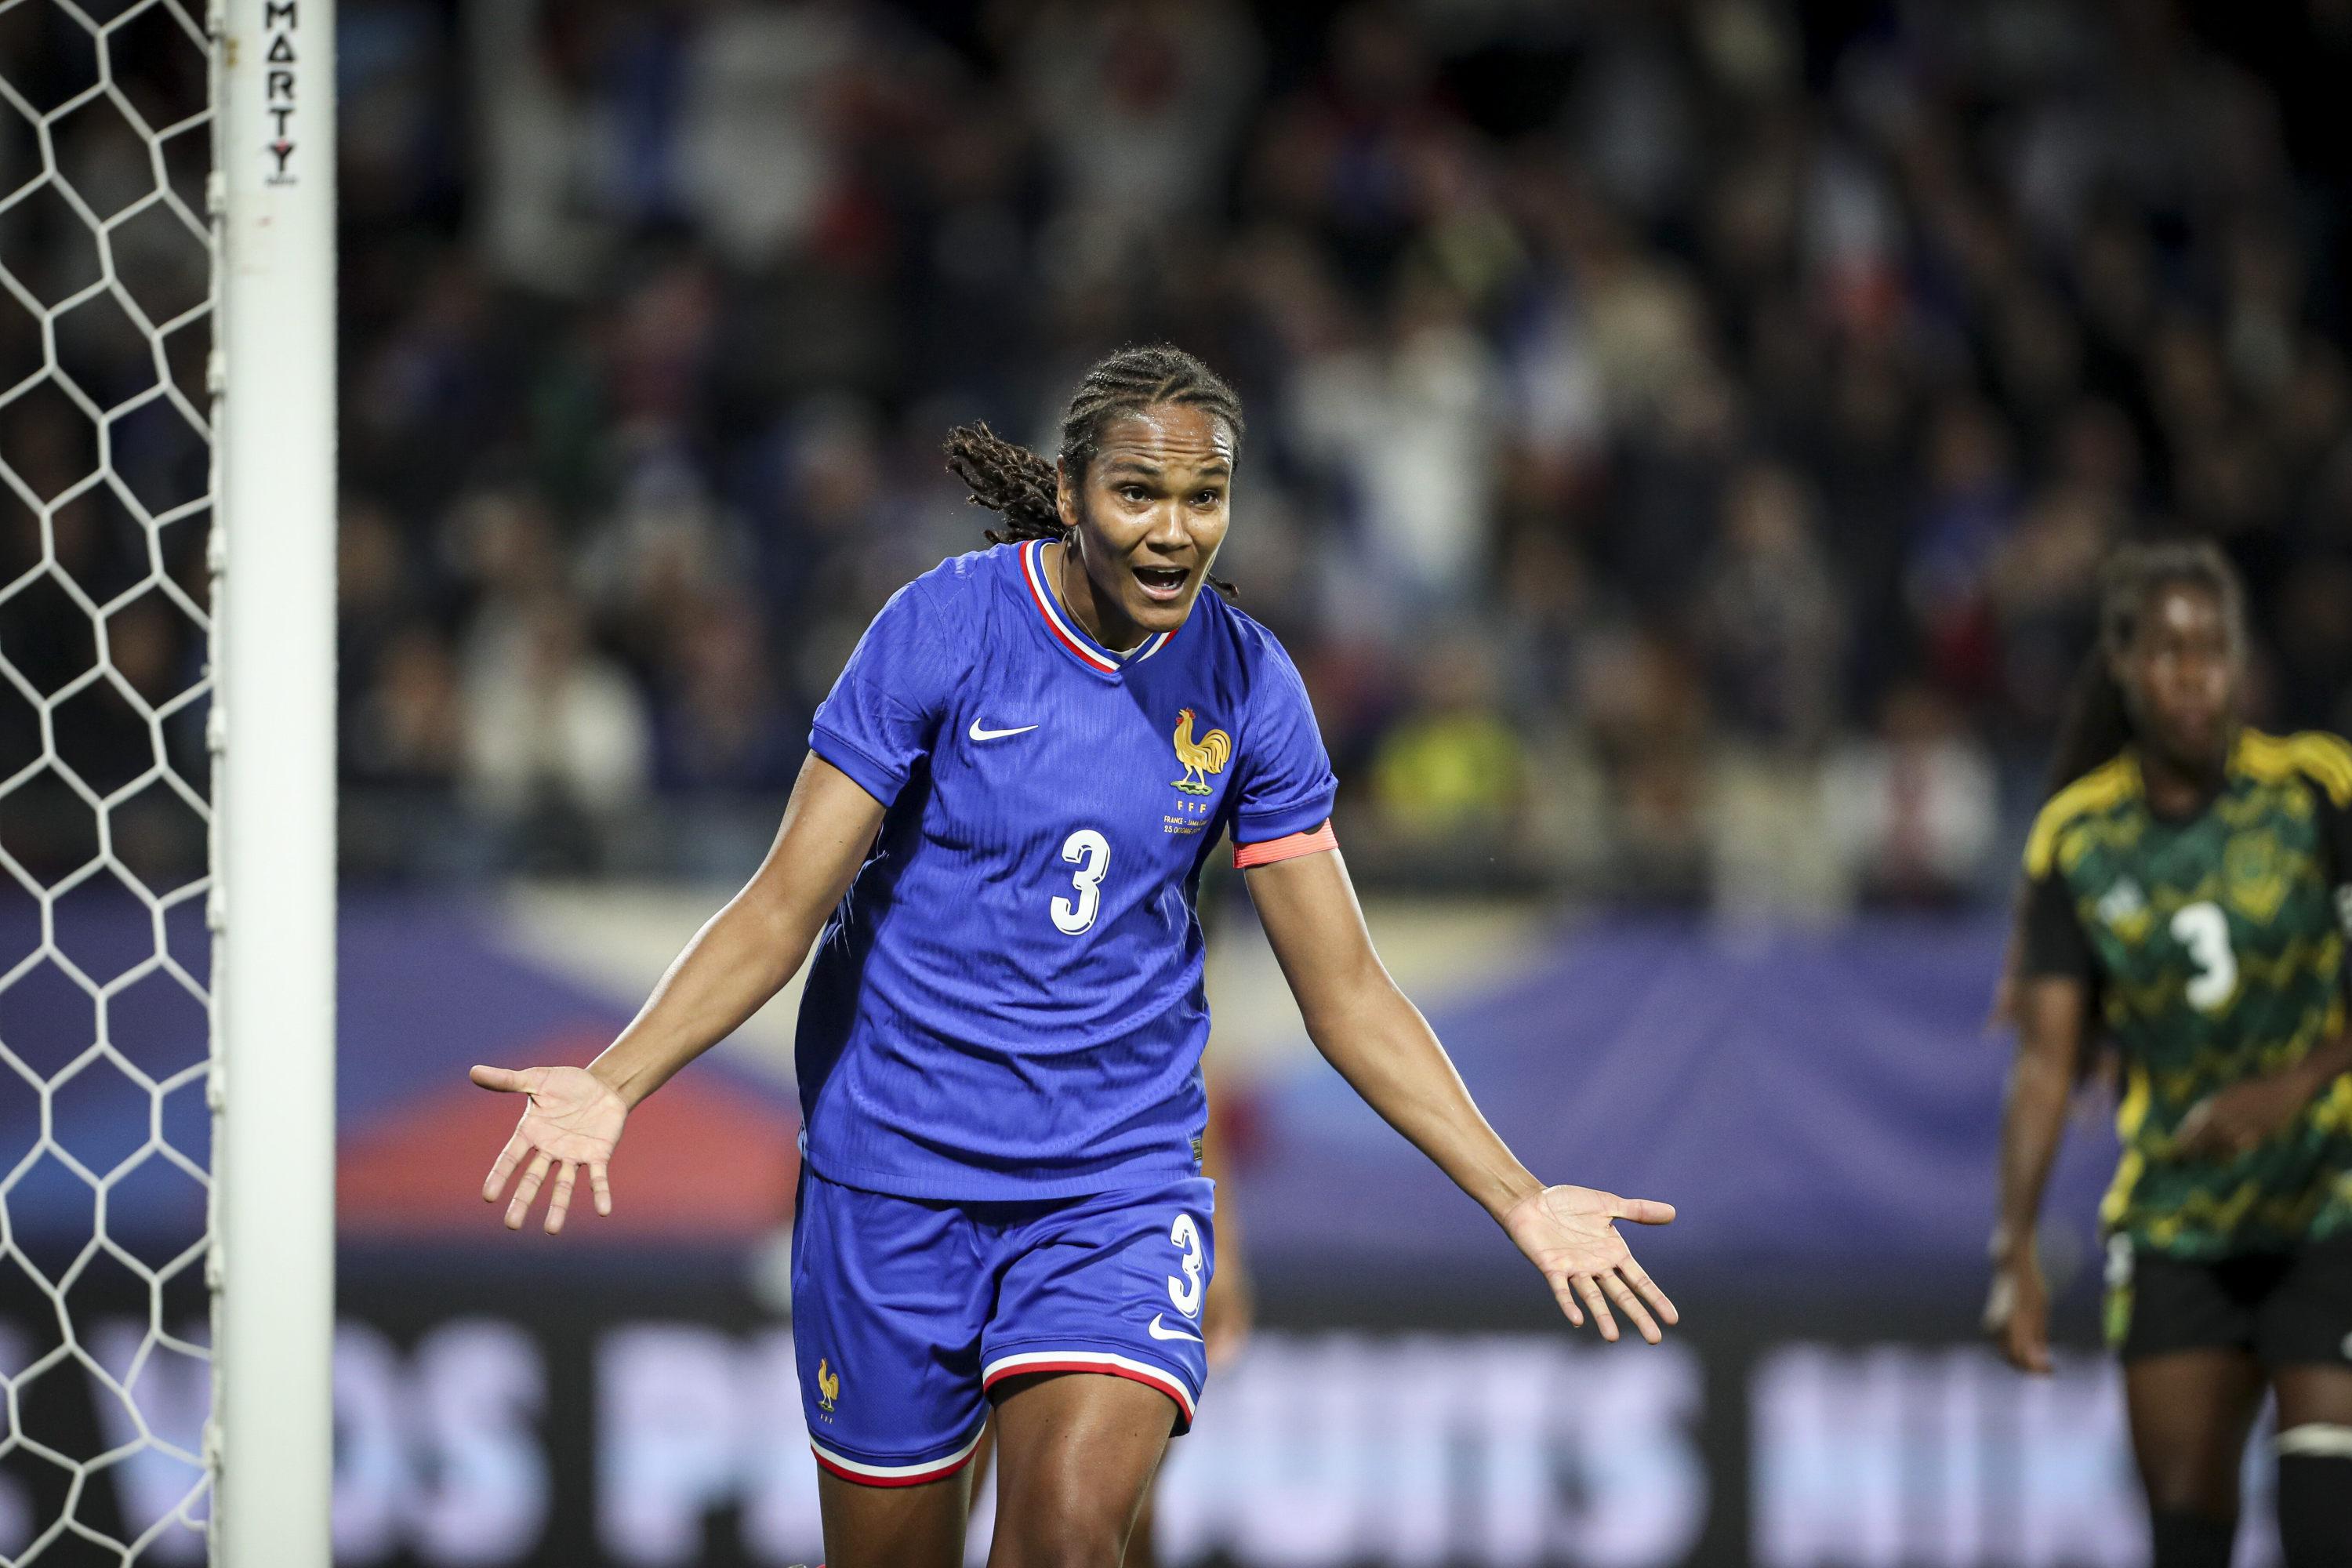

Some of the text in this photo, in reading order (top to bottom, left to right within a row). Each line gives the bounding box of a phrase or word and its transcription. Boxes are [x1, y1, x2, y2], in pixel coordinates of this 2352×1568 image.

[266, 0, 296, 172] MARTY
[1163, 815, 1183, 825] FRANCE
[1050, 829, 1110, 935] 3
[2170, 900, 2238, 1011] 3
[1167, 1214, 1202, 1318] 3
